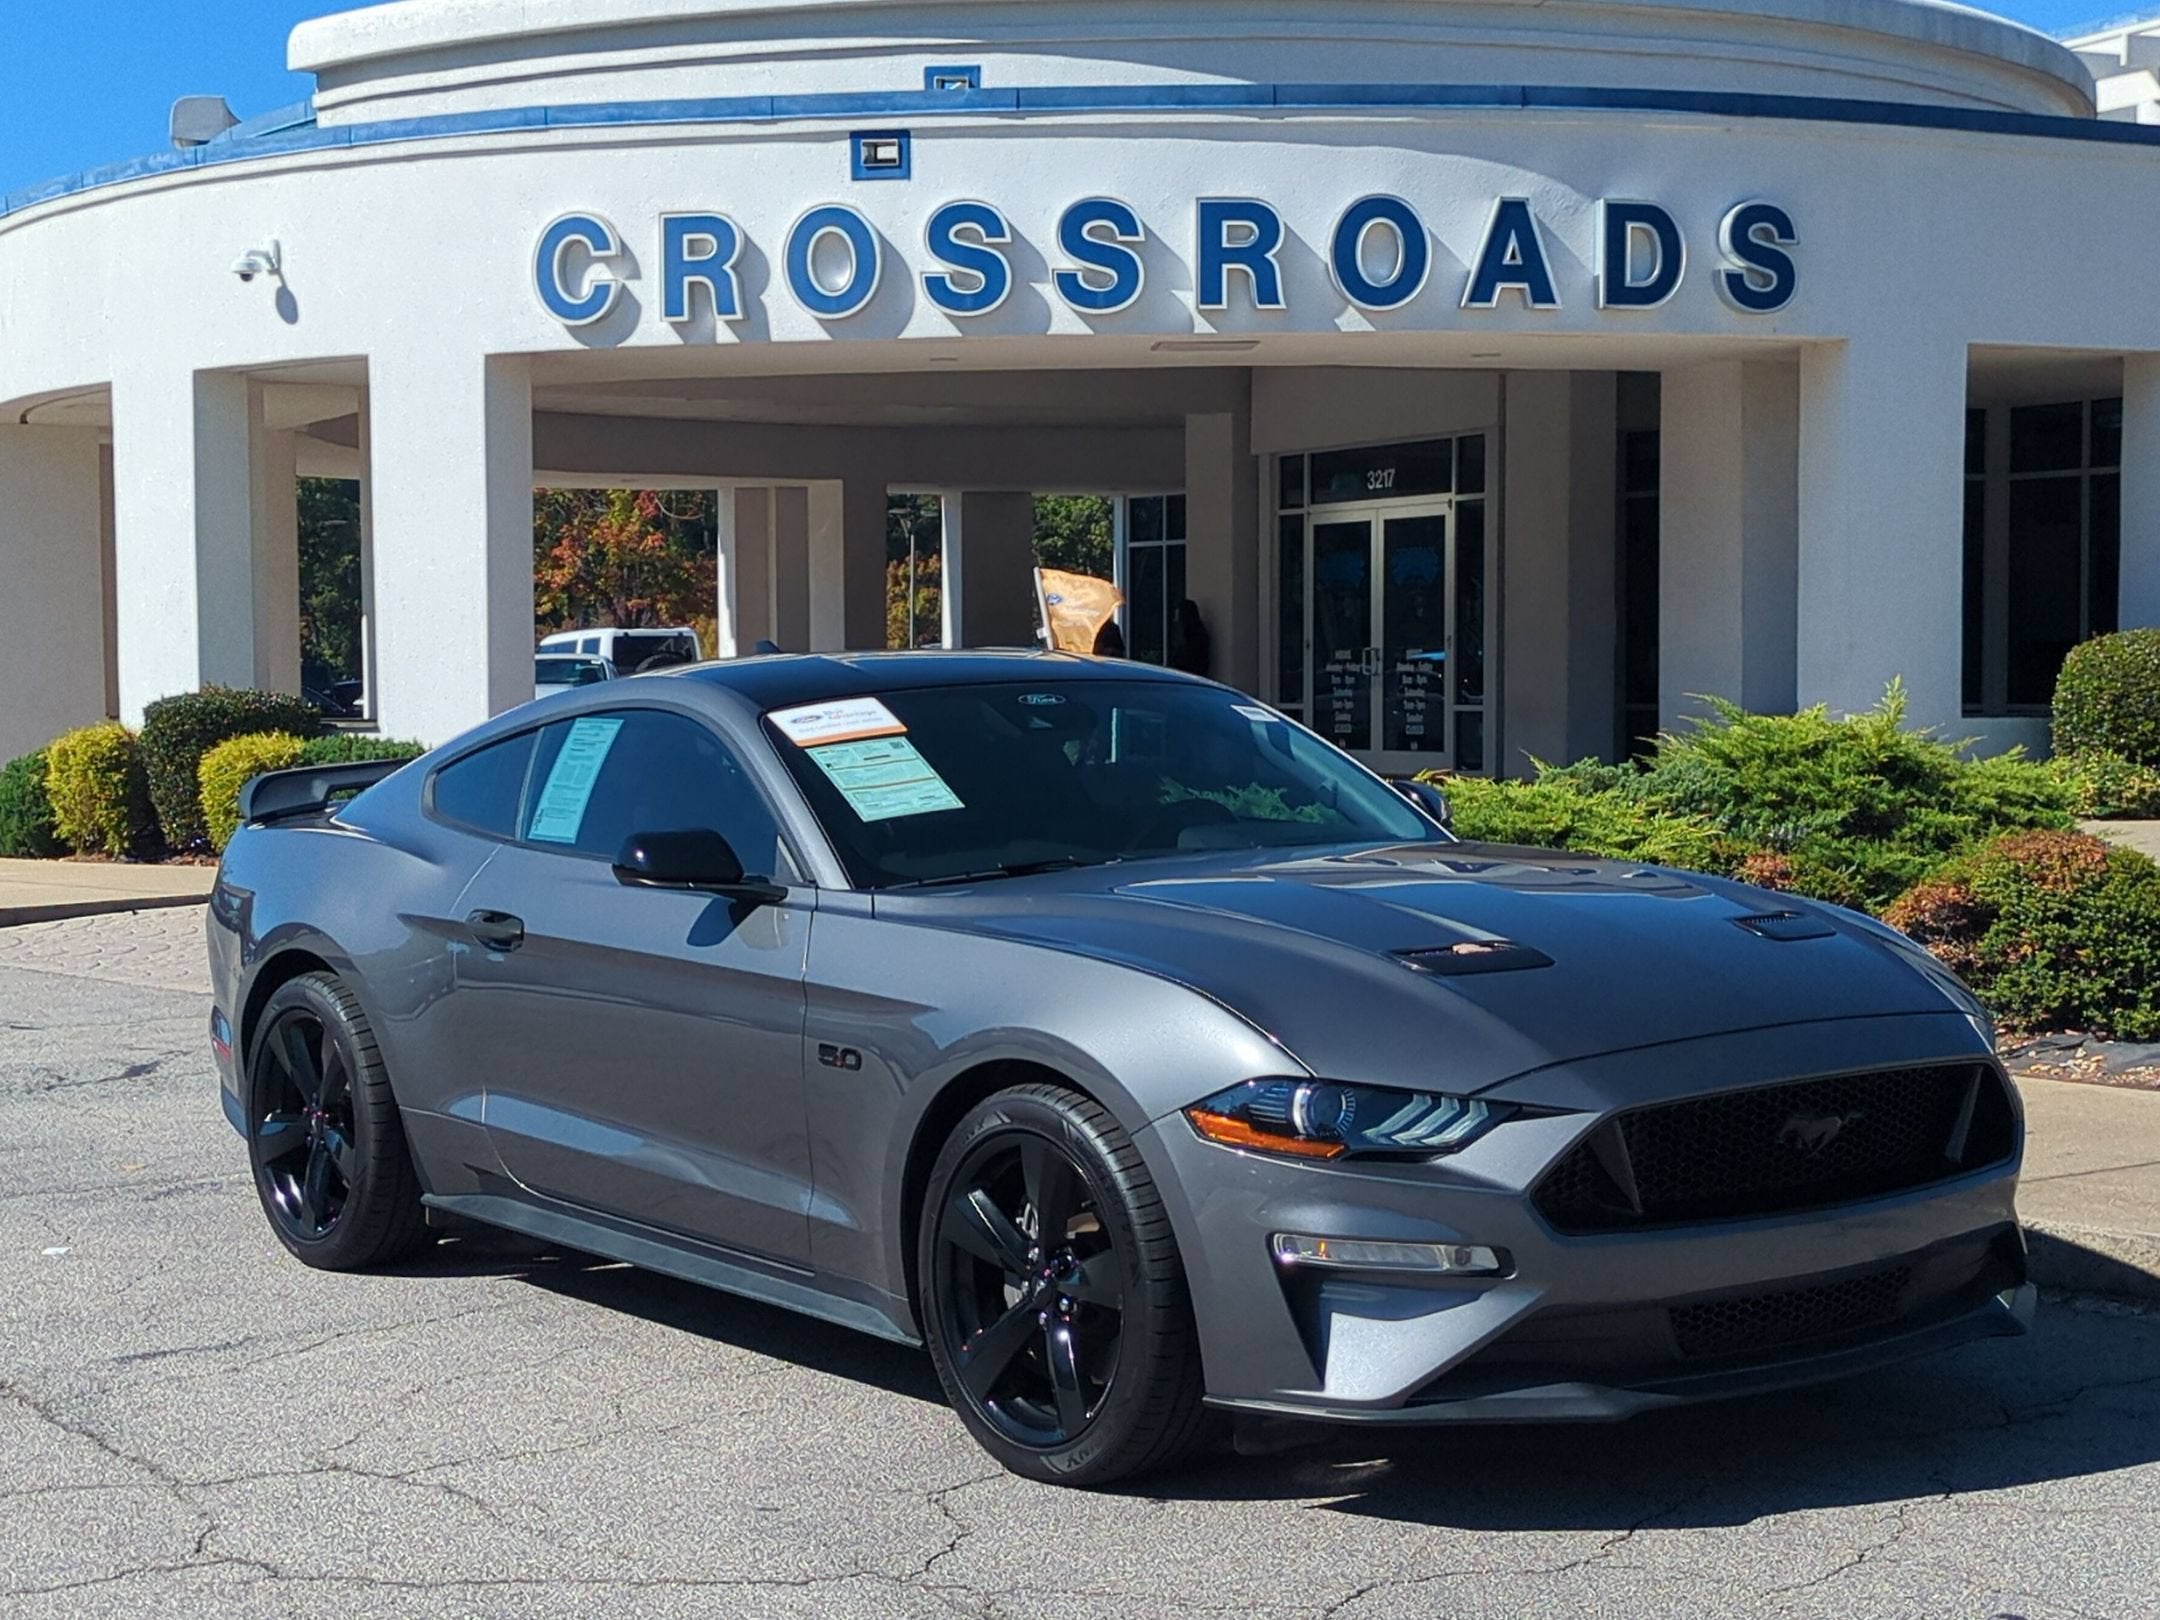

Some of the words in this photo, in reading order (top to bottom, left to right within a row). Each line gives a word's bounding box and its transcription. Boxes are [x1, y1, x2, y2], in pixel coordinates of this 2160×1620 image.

[532, 194, 1800, 327] CROSSROADS
[1367, 468, 1396, 490] 3217
[818, 1042, 862, 1071] 5.0
